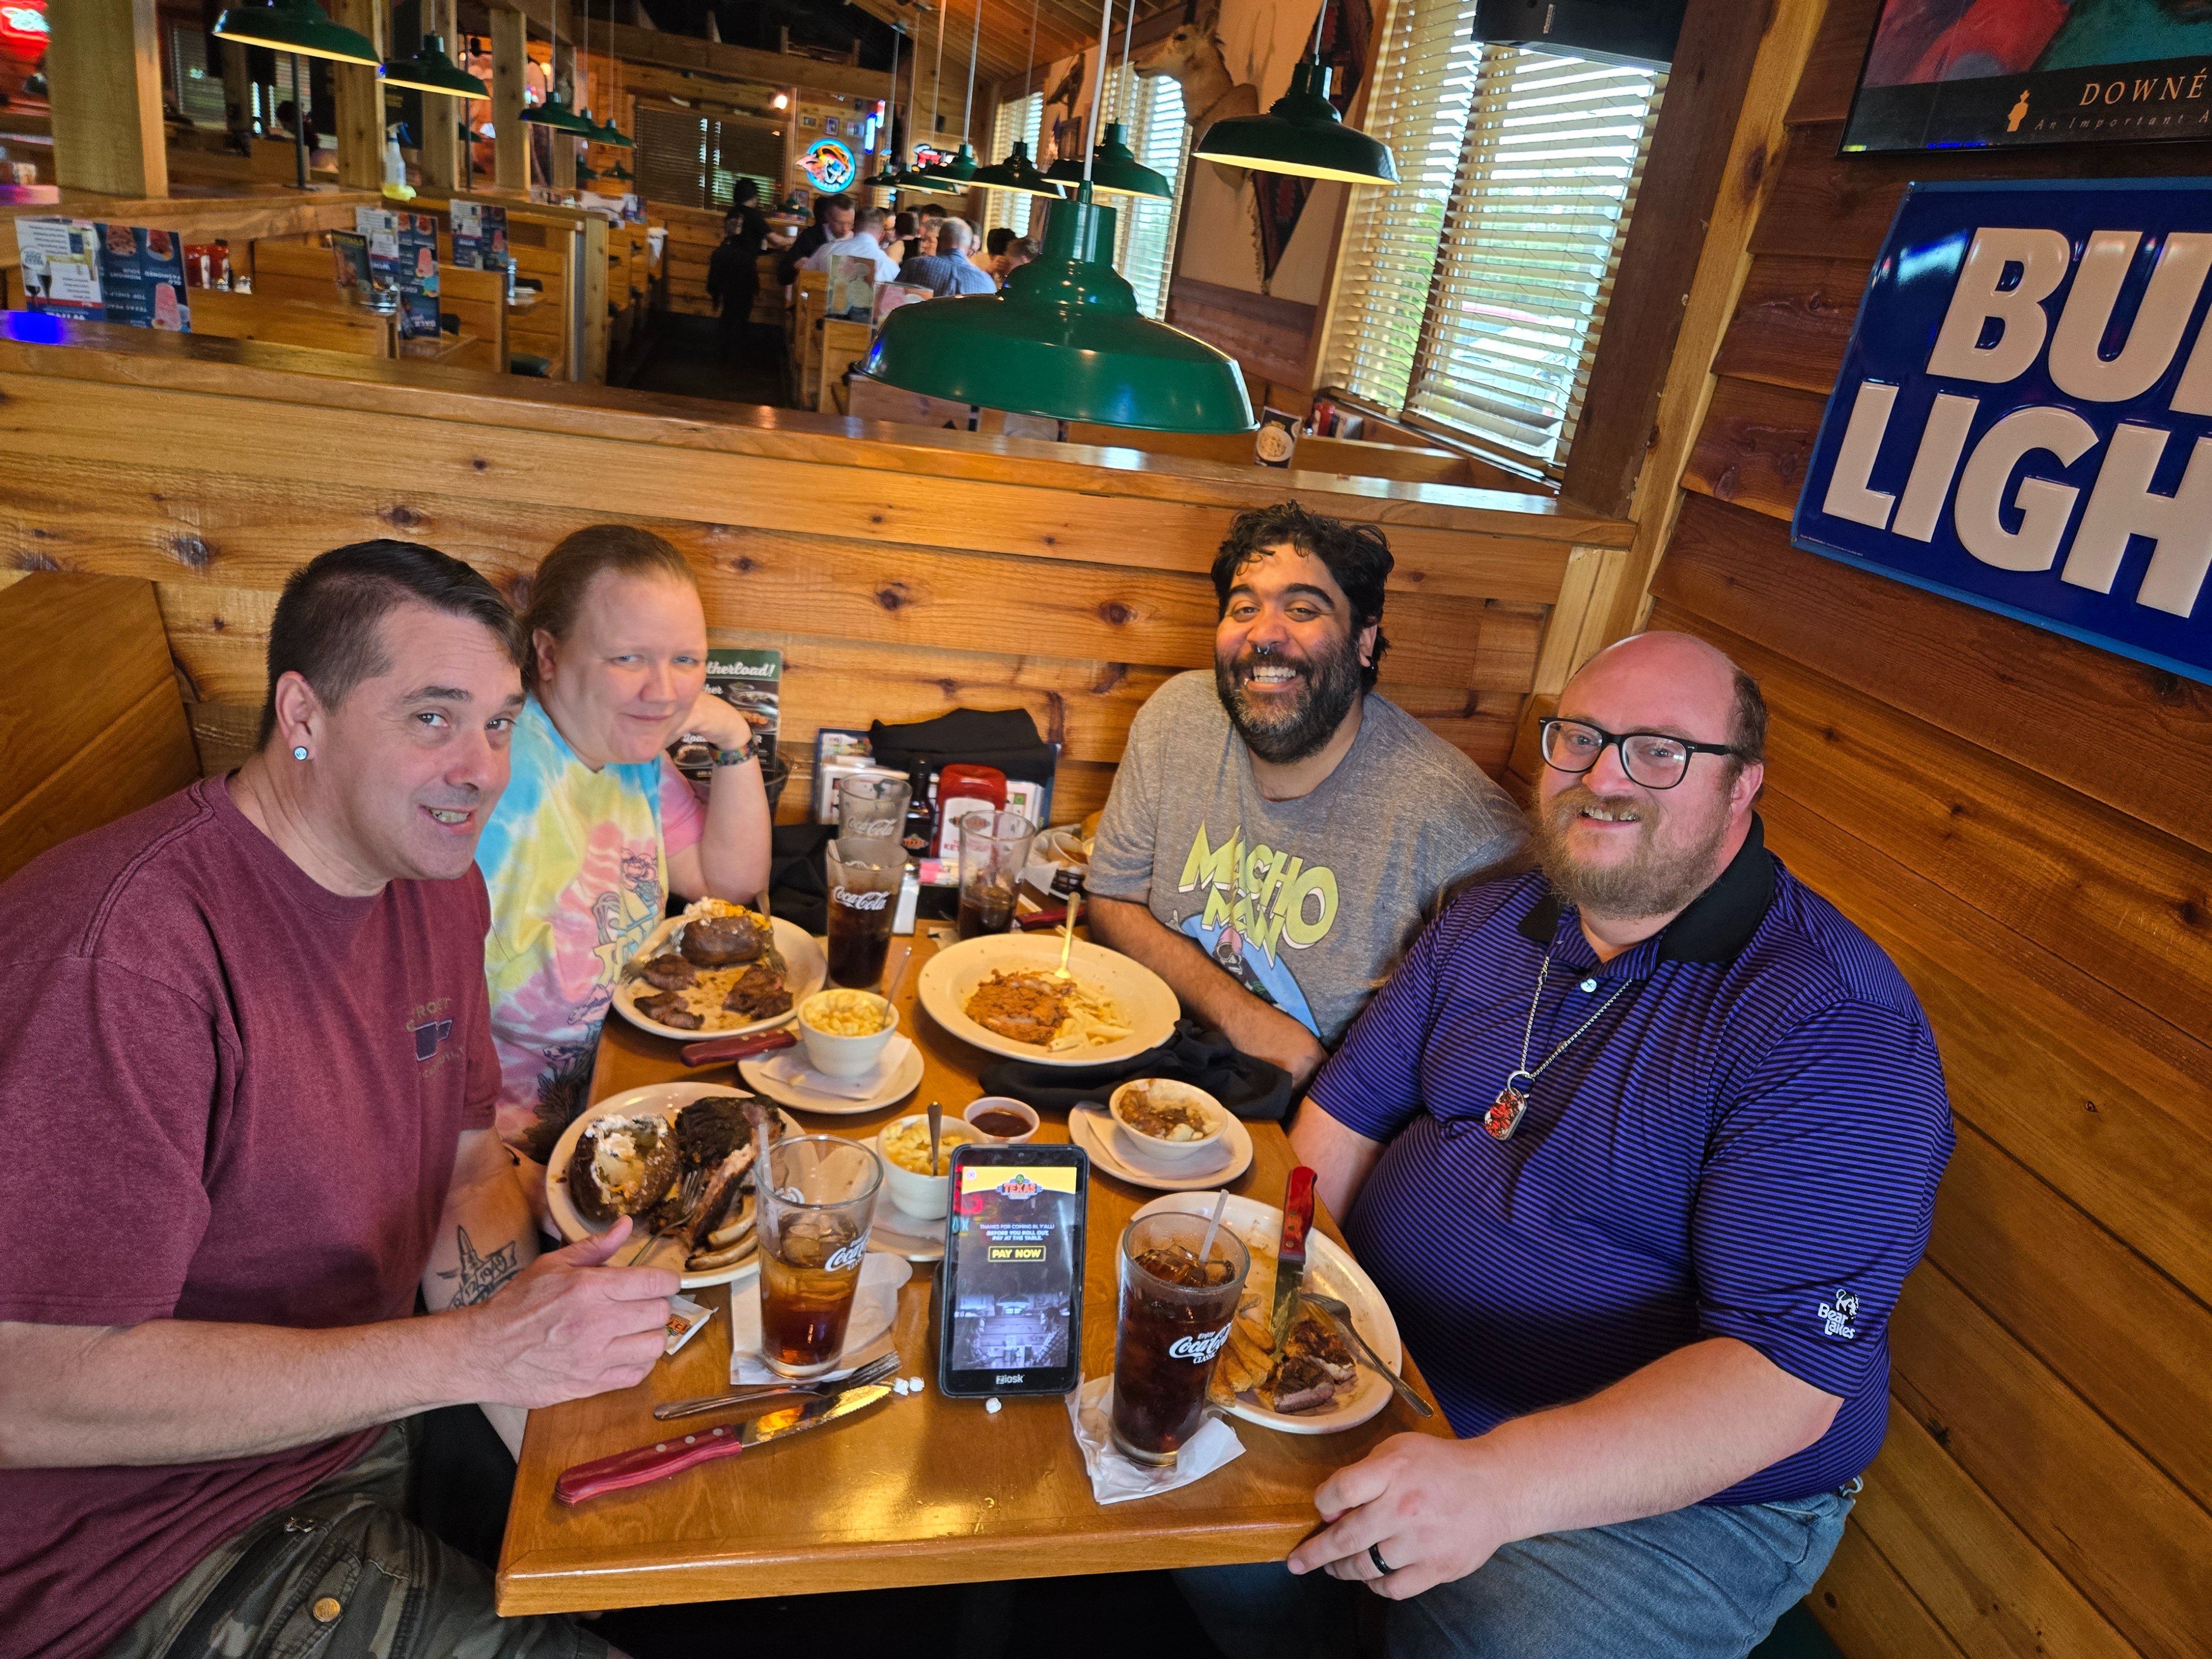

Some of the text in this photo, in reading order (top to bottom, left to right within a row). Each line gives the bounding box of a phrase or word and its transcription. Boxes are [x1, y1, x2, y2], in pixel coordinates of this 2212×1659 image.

[2079, 67, 2208, 106] DOWNÉ
[2035, 119, 2057, 131] An
[2069, 113, 2184, 129] Important
[703, 682, 723, 695] her
[1178, 818, 1339, 950] MACHO
[833, 885, 891, 911] Coca-Cola
[1004, 1183, 1036, 1193] TEXAS
[992, 1249, 1041, 1258] PAY NOW
[1817, 1302, 1848, 1324] Bear
[1824, 1319, 1855, 1339] Lakes
